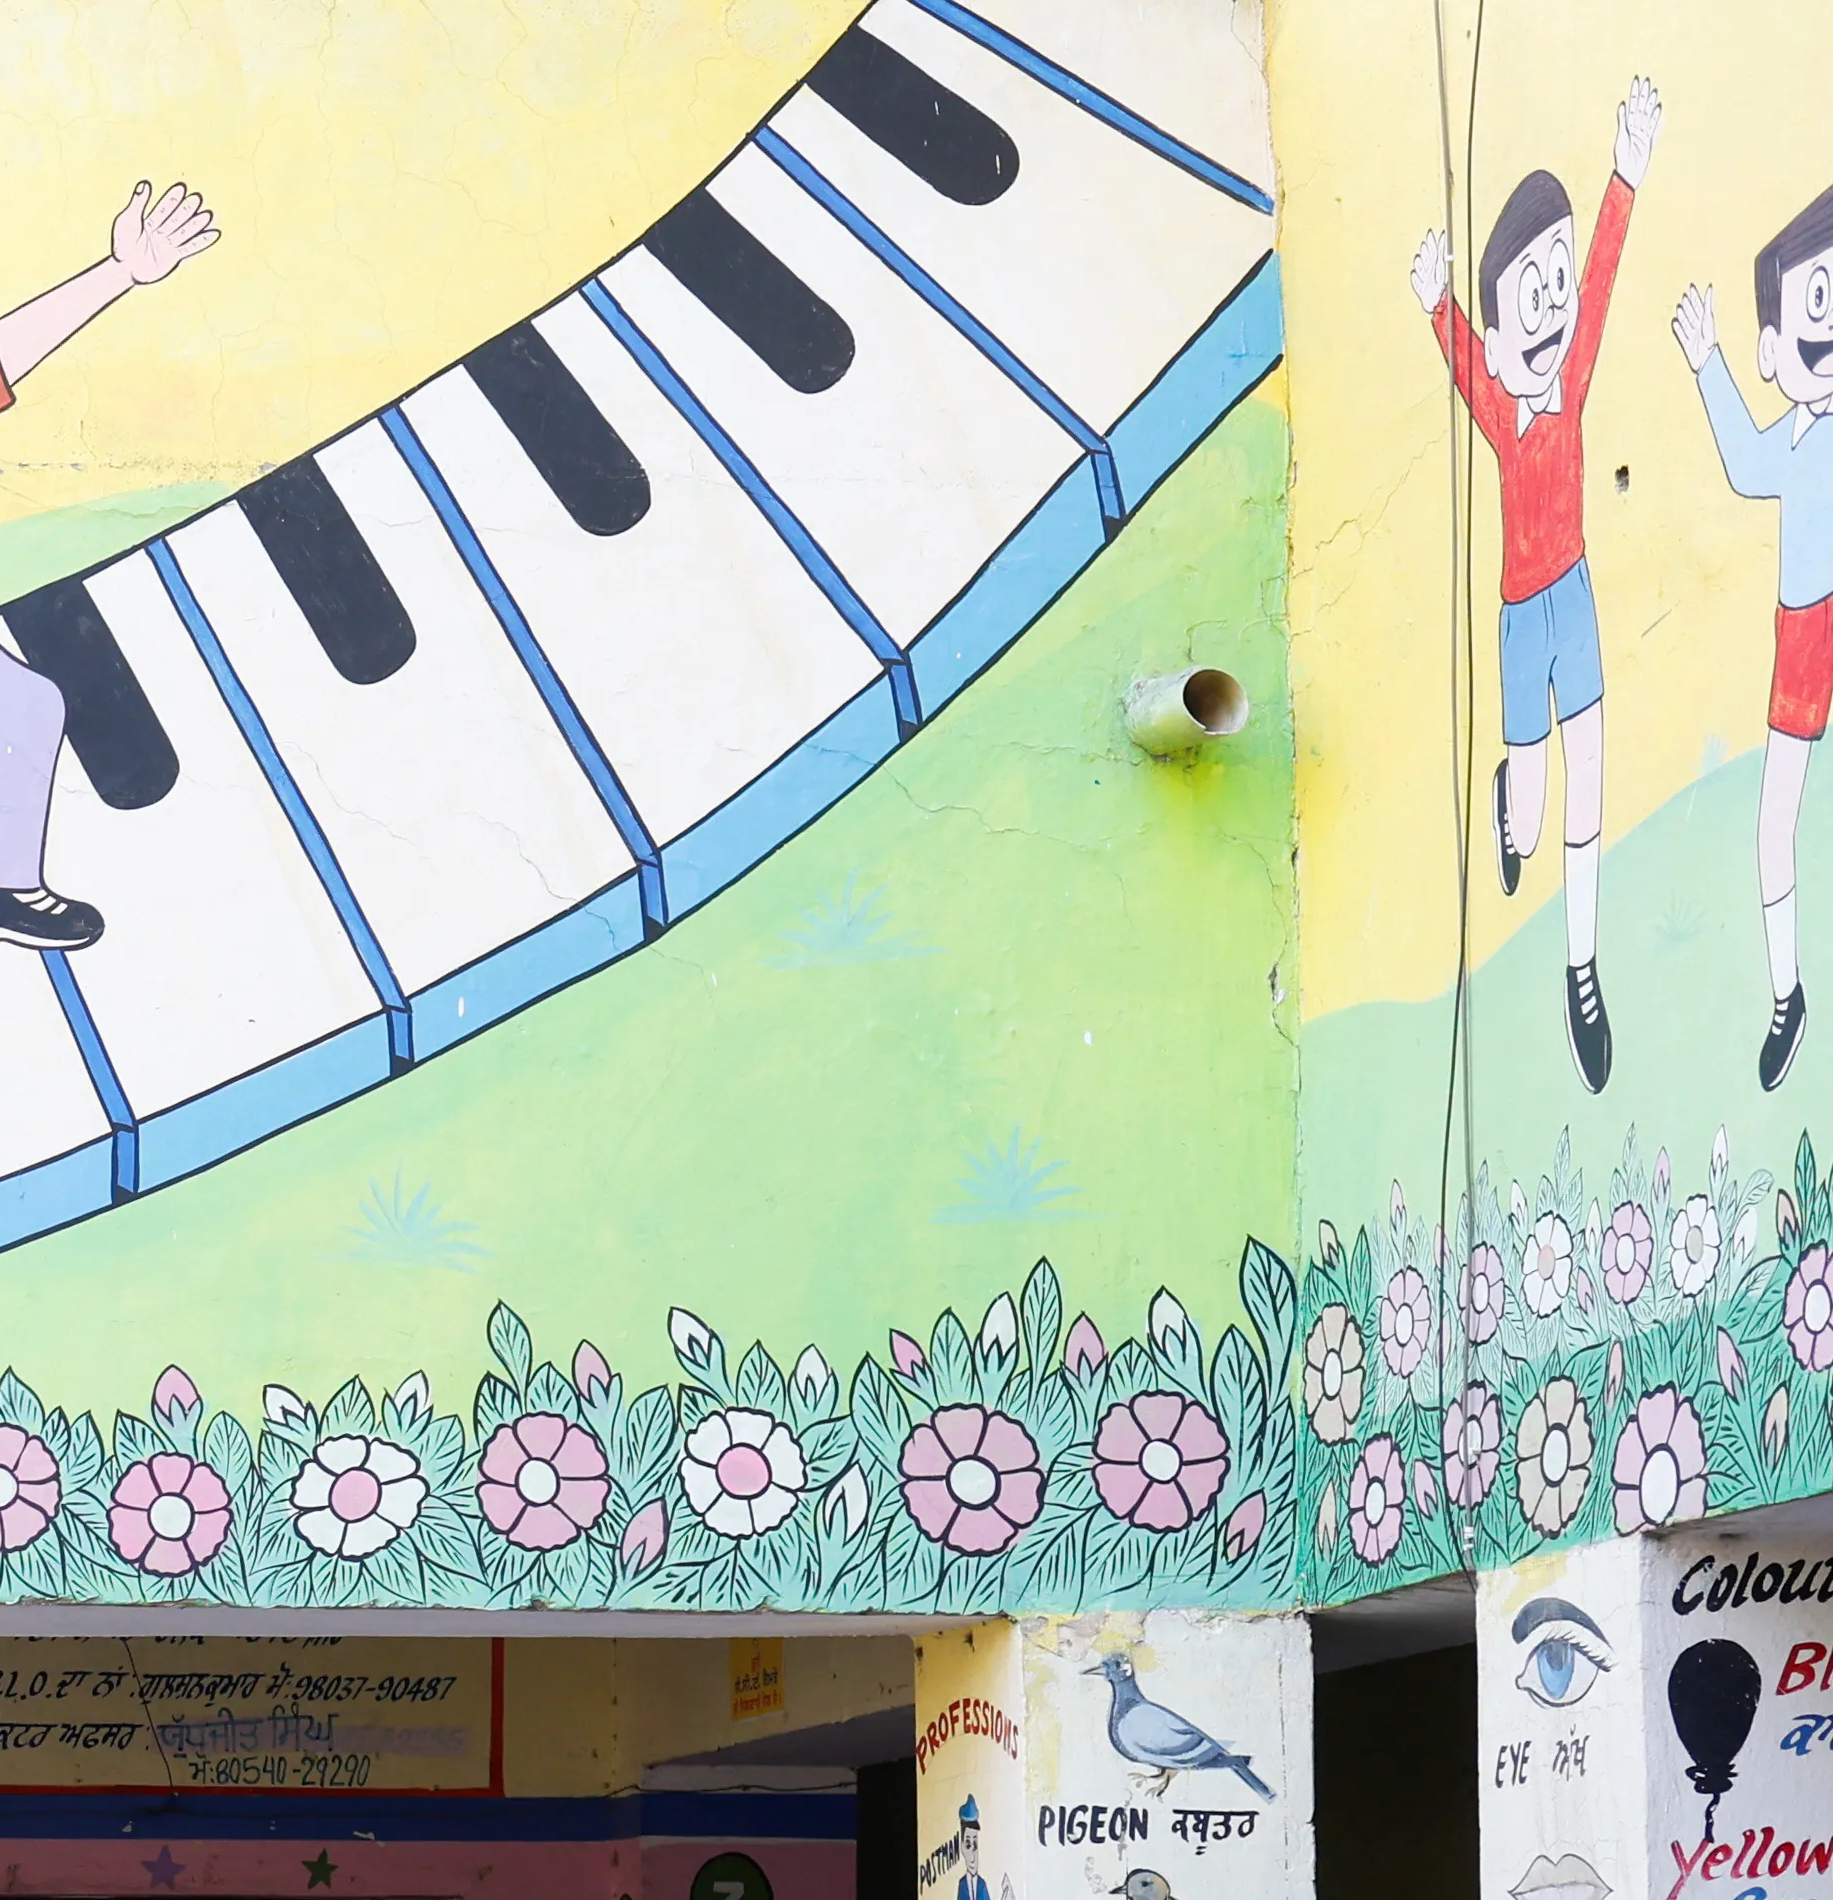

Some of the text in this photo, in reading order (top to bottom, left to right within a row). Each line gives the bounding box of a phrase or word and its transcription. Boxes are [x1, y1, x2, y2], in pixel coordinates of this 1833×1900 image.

[915, 1697, 1020, 1776] PROFESSIONS
[1495, 1739, 1531, 1789] EYE
[1038, 1804, 1149, 1847] PIGEON
[919, 1829, 962, 1895] POSTMAN
